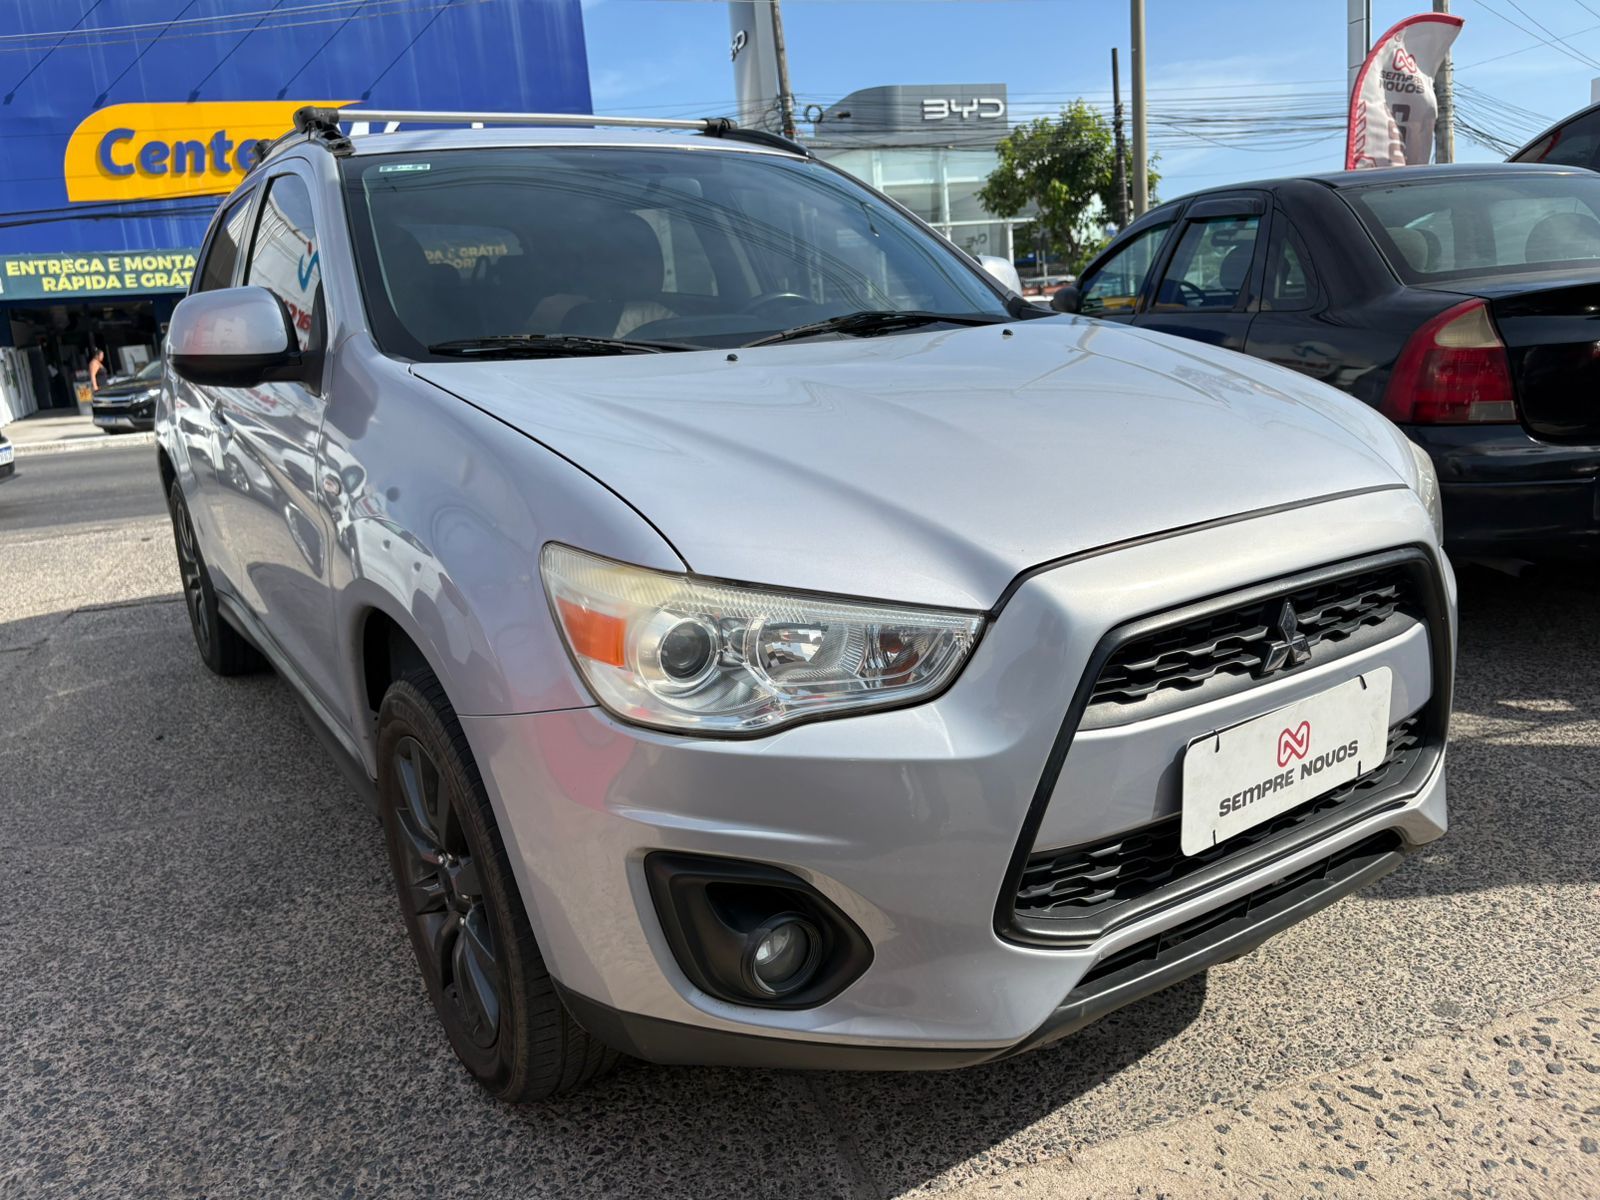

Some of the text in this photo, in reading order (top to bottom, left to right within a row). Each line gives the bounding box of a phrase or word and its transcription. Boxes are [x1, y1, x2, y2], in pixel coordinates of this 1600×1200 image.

[922, 98, 1005, 120] BYD
[5, 258, 106, 277] ENTREGA
[108, 257, 121, 273] E
[42, 272, 122, 292] RÁPIDA
[124, 273, 138, 289] E
[1219, 768, 1295, 817] SEMPRE
